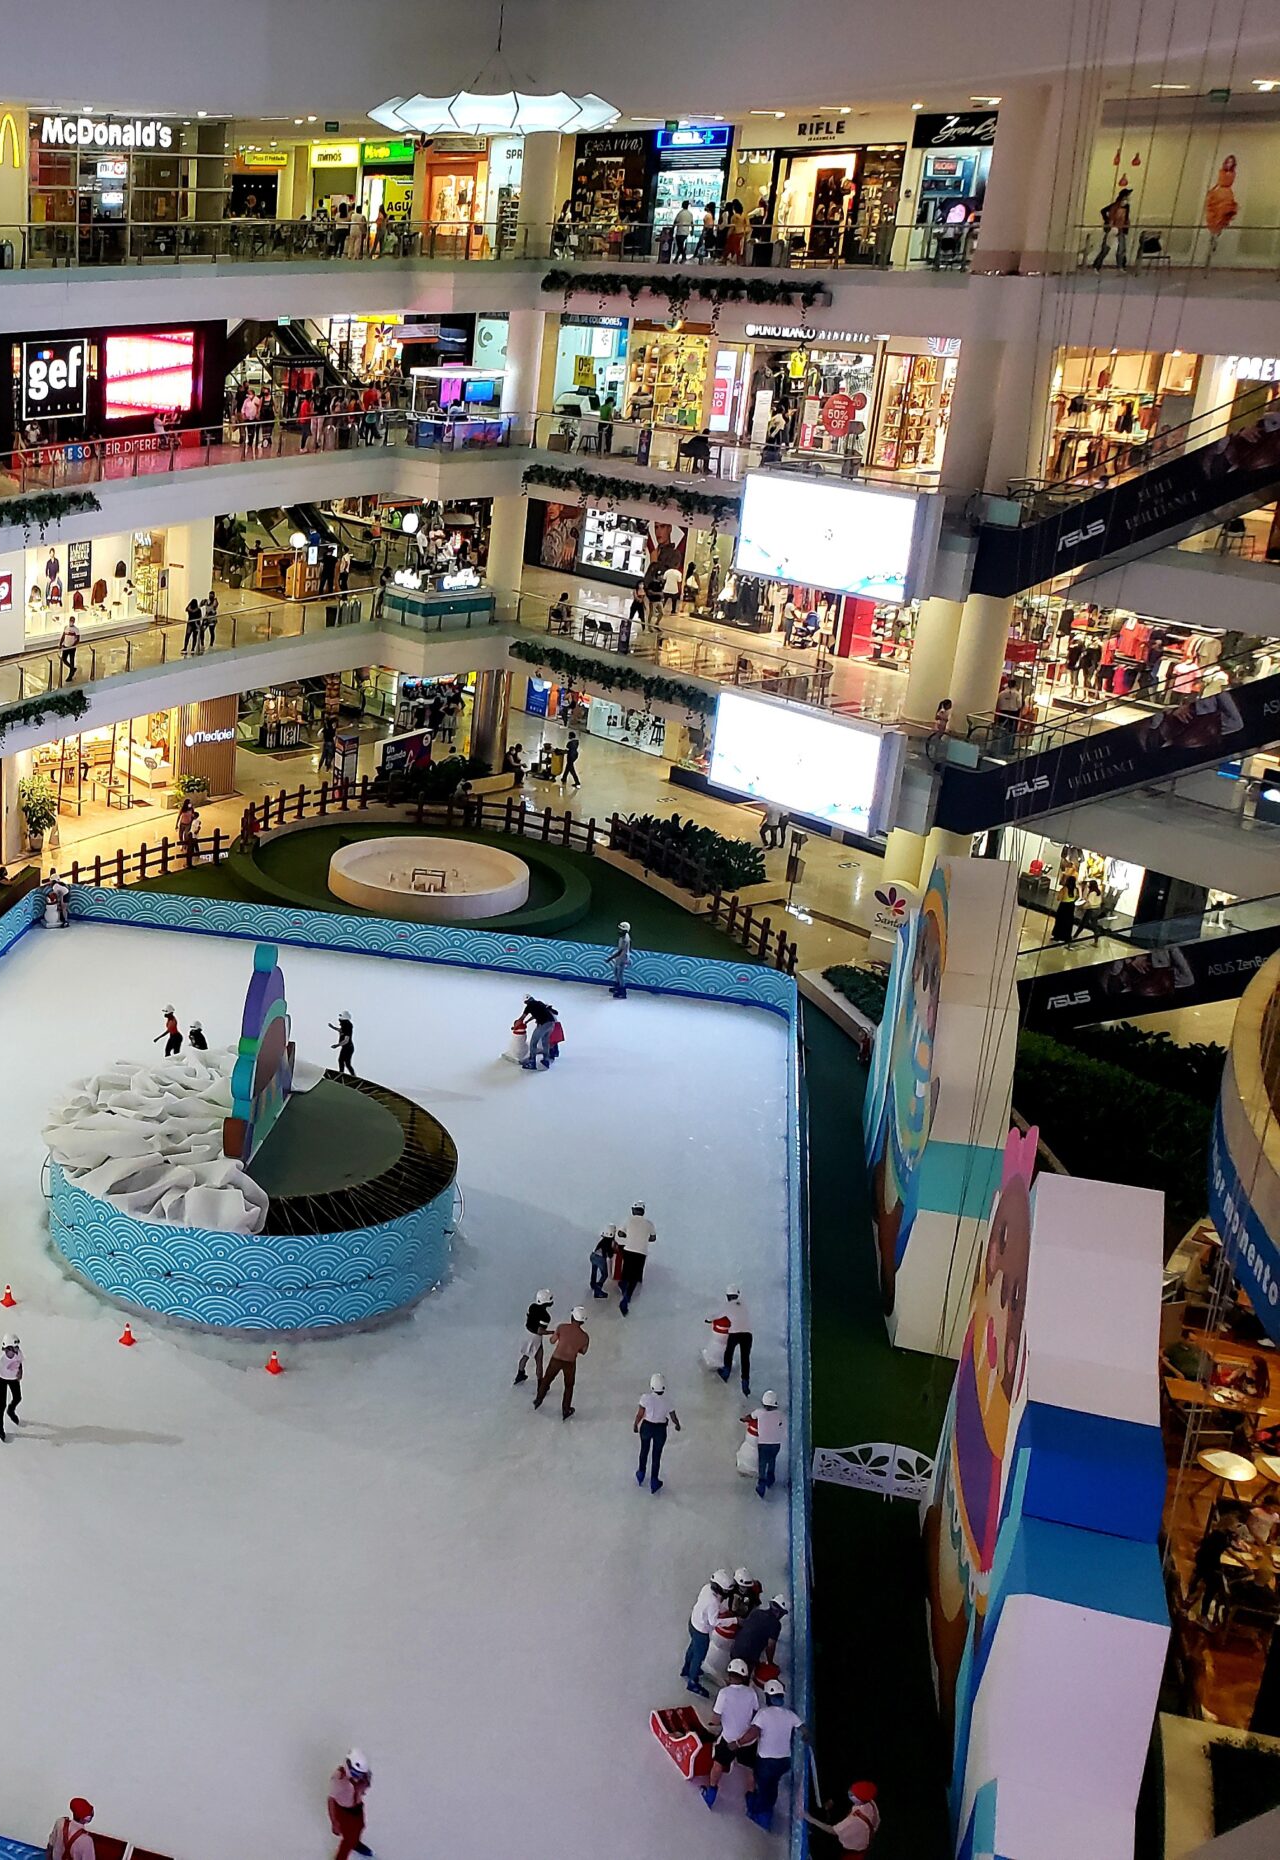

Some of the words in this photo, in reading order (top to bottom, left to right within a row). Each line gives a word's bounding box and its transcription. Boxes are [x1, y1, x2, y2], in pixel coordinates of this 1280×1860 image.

[41, 116, 173, 148] McDonald's
[797, 120, 846, 136] RIFLE
[586, 139, 611, 151] CASA
[28, 346, 82, 401] gef
[1224, 355, 1280, 381] FORE
[827, 409, 849, 420] 50%
[831, 420, 846, 429] OFF
[77, 440, 121, 460] SOEÍR
[1057, 518, 1106, 552] ASUS
[306, 566, 322, 579] LIV
[1263, 701, 1280, 718] AS
[194, 727, 235, 744] Medipiel
[1005, 774, 1050, 800] ASUS
[874, 912, 907, 928] Santa
[1208, 963, 1236, 976] ASUS
[1237, 956, 1270, 971] ZenBo
[1046, 989, 1091, 1010] ASUS
[1223, 1192, 1278, 1306] momento
